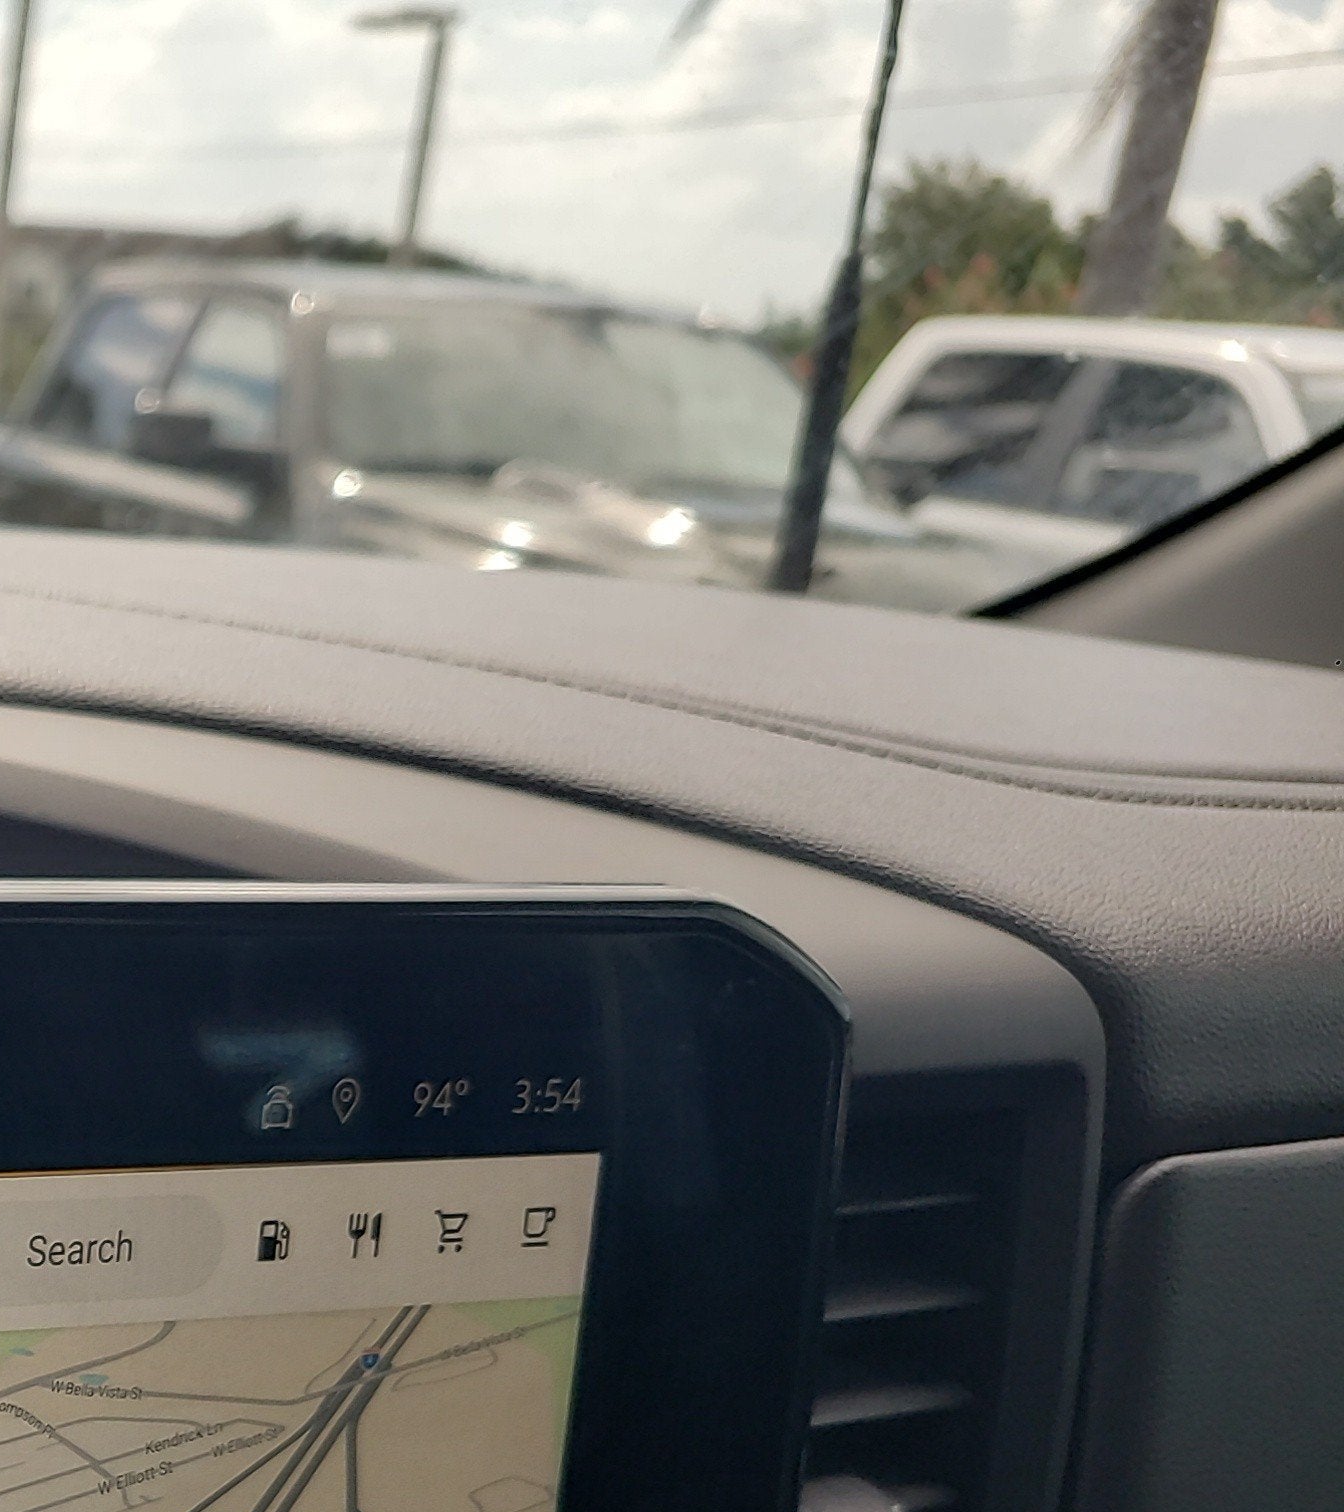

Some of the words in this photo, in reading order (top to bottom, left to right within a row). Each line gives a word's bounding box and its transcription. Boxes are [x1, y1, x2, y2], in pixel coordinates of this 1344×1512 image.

[512, 1078, 582, 1114] 3:54
[27, 1230, 133, 1268] Search
[98, 1480, 111, 1495] W
[159, 1461, 173, 1476] St
